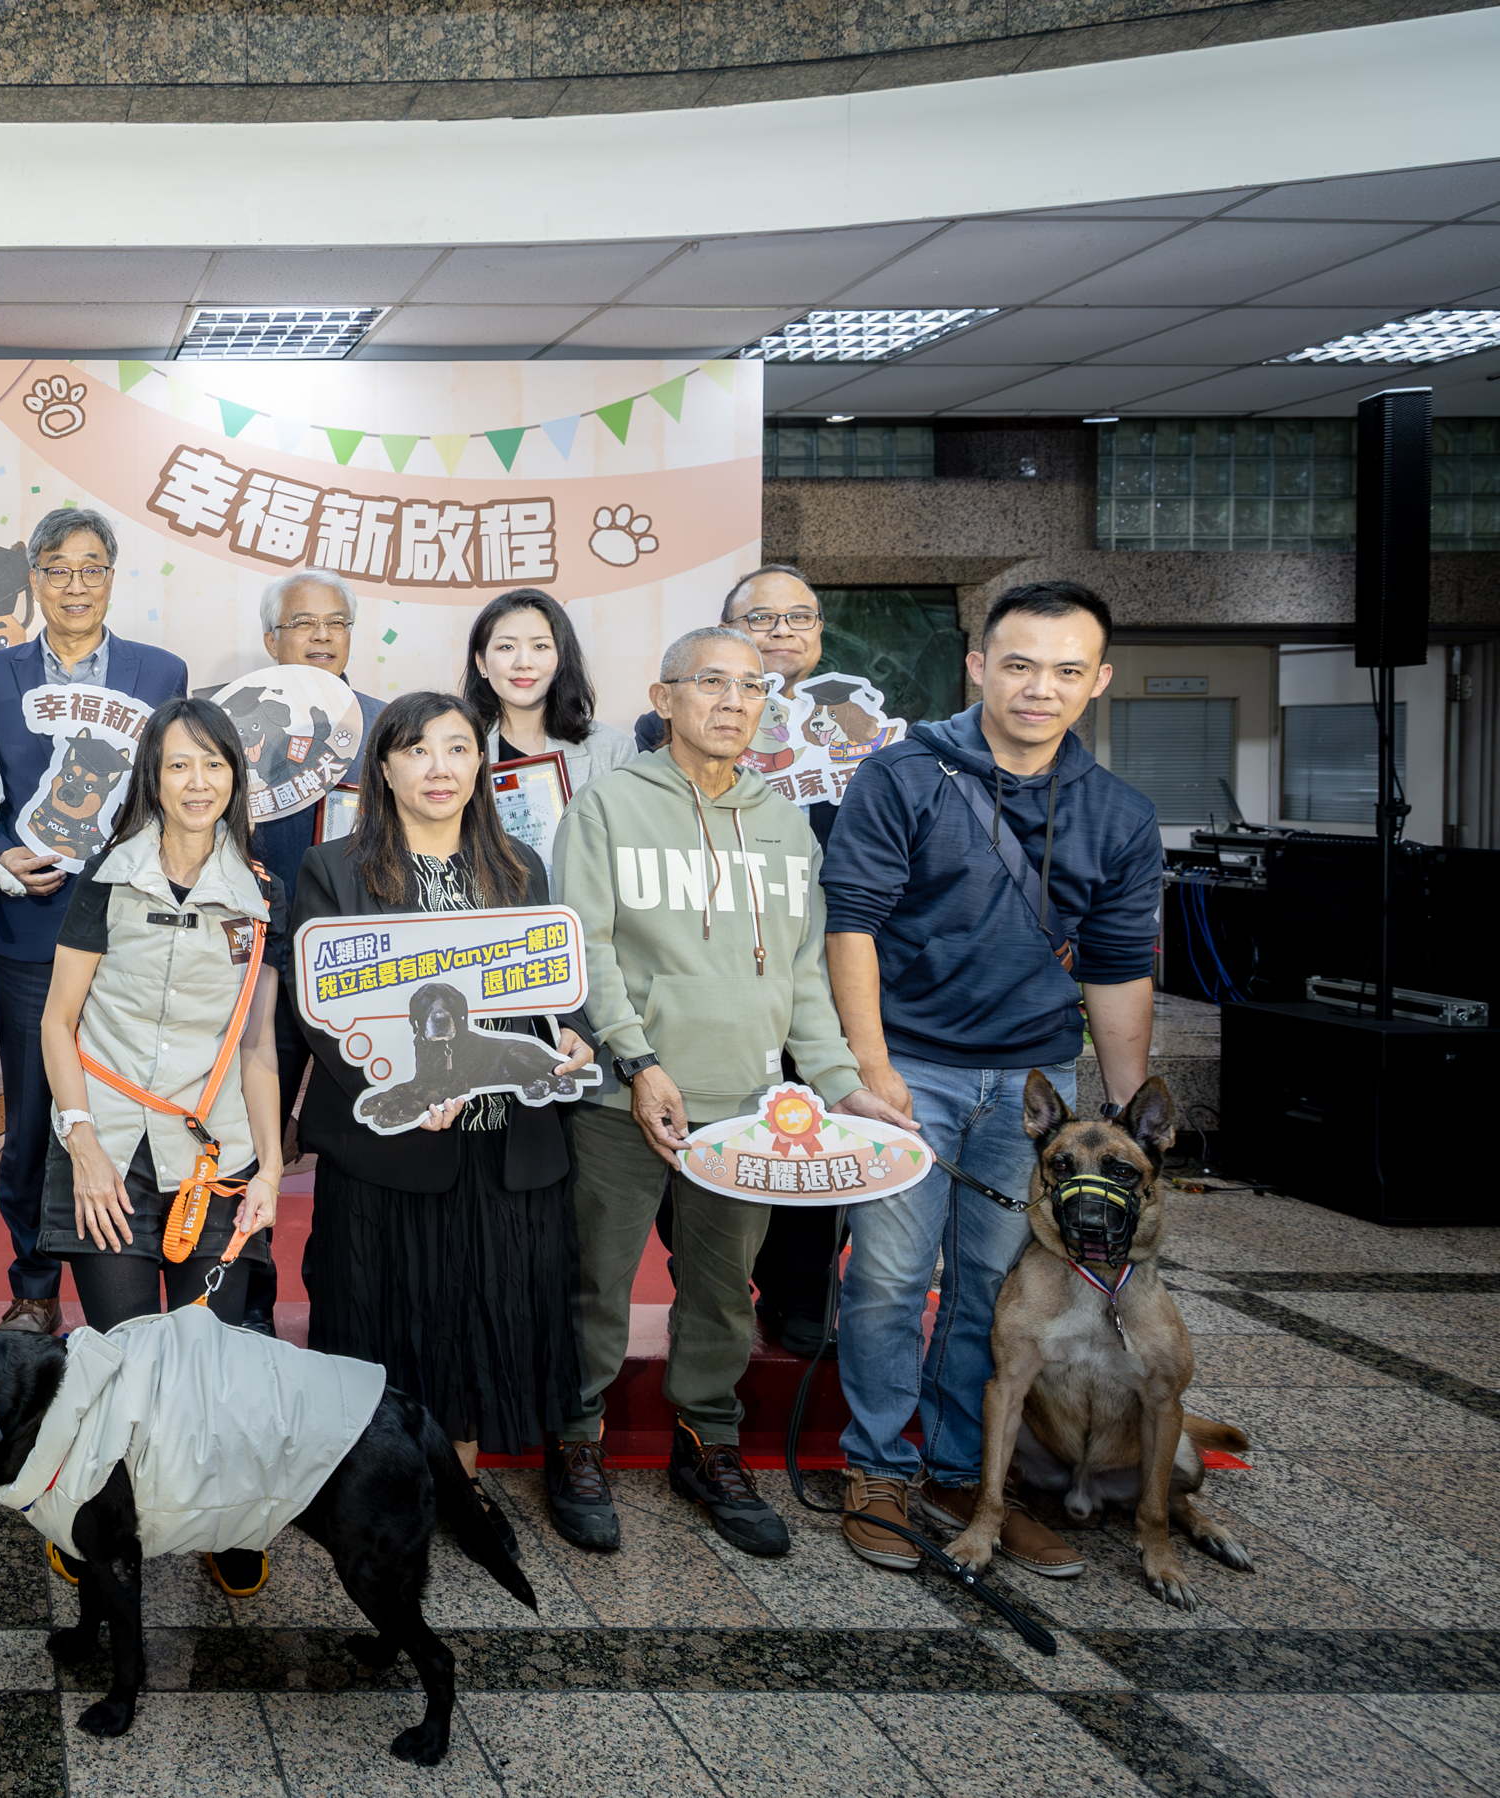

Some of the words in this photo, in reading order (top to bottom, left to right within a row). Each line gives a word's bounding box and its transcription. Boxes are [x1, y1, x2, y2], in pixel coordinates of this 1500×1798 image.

[153, 448, 557, 583] 幸福新啟程
[741, 755, 766, 768] CUSTOMS
[249, 751, 345, 818] 護國神犬
[47, 820, 70, 837] POLICE
[80, 822, 91, 831] K-9
[483, 956, 570, 998] 退休生活
[736, 1154, 865, 1193] 榮耀退役
